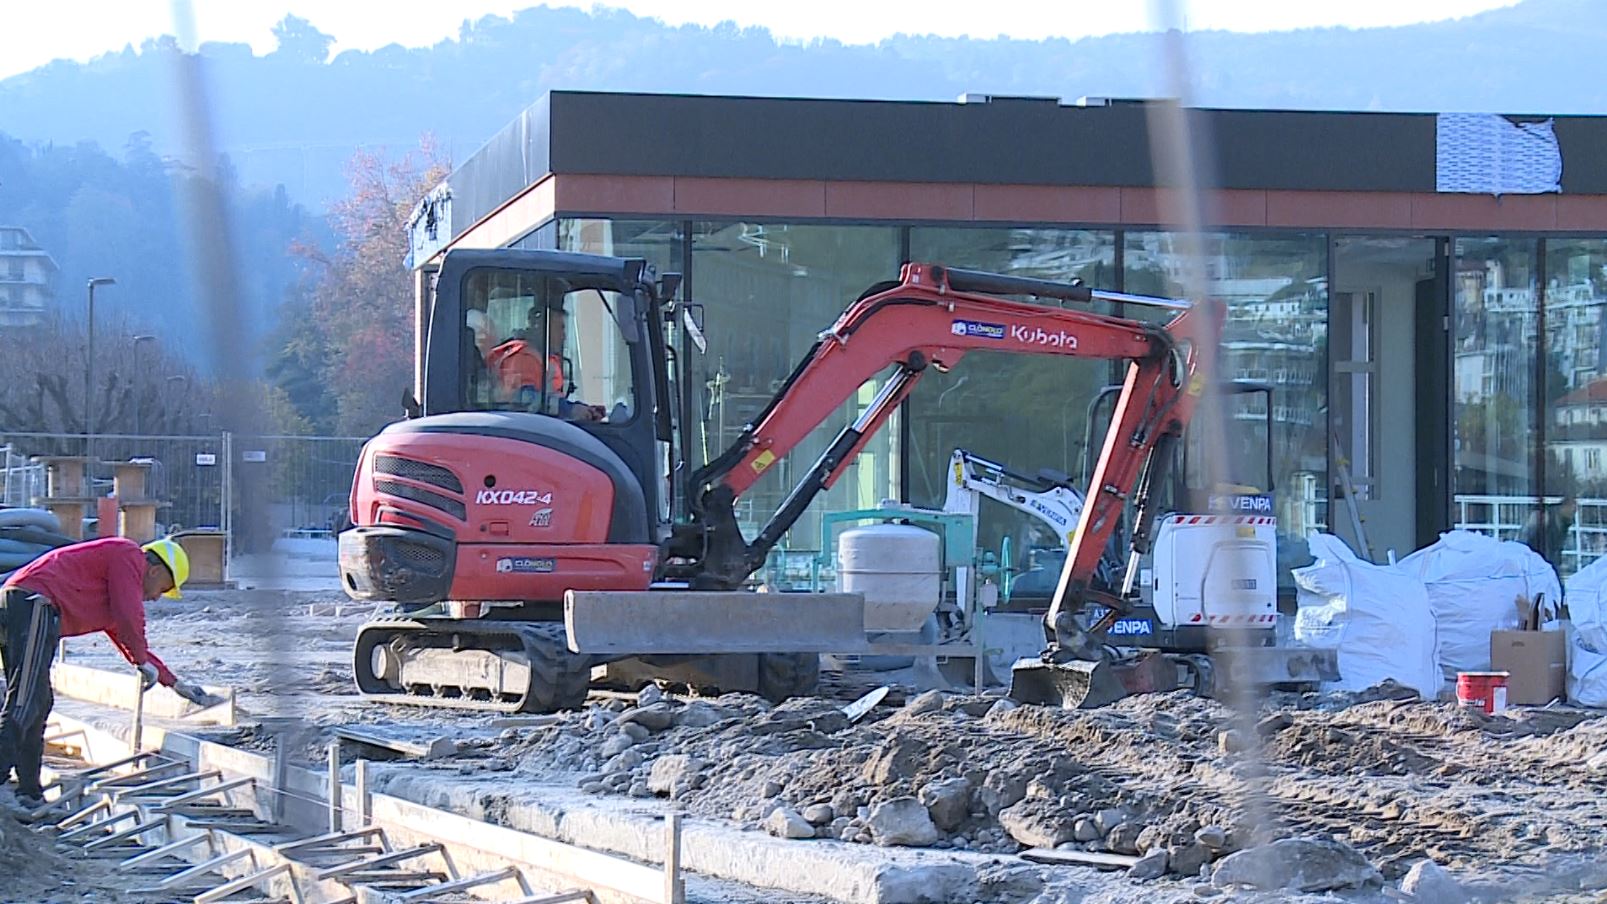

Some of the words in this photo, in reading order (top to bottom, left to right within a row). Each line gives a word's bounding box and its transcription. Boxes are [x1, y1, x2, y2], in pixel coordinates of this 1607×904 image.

[1011, 323, 1078, 349] Kubota
[475, 490, 552, 505] KX042-4
[1229, 496, 1272, 511] VENPA
